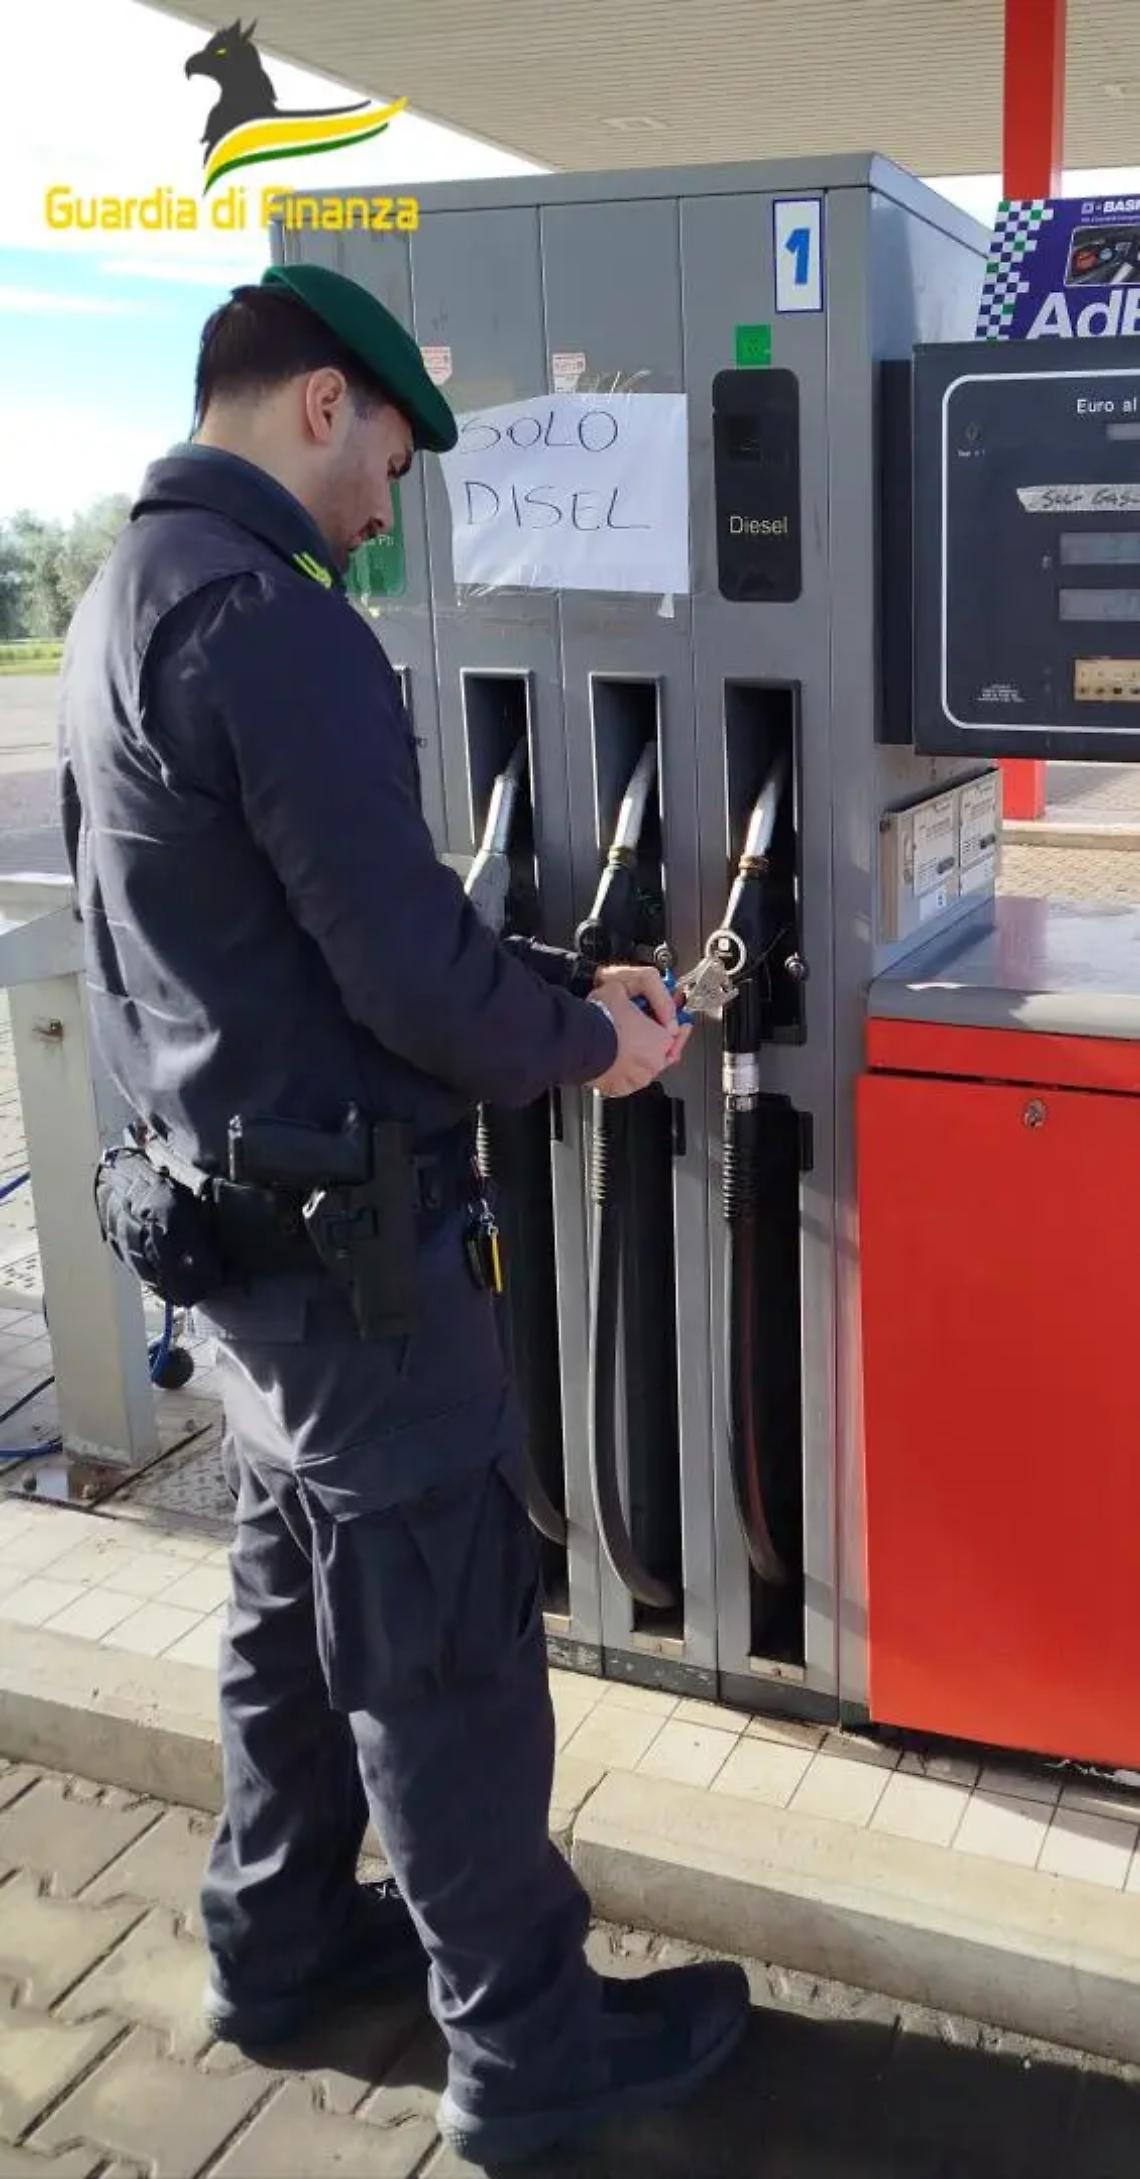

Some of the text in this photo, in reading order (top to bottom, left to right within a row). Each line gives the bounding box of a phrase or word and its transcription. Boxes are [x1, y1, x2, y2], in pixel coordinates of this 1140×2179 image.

[785, 228, 811, 285] 1
[1077, 397, 1137, 414] Euro al
[460, 410, 619, 454] SOLO
[464, 481, 652, 531] DISEL
[729, 515, 788, 534] Diesel
